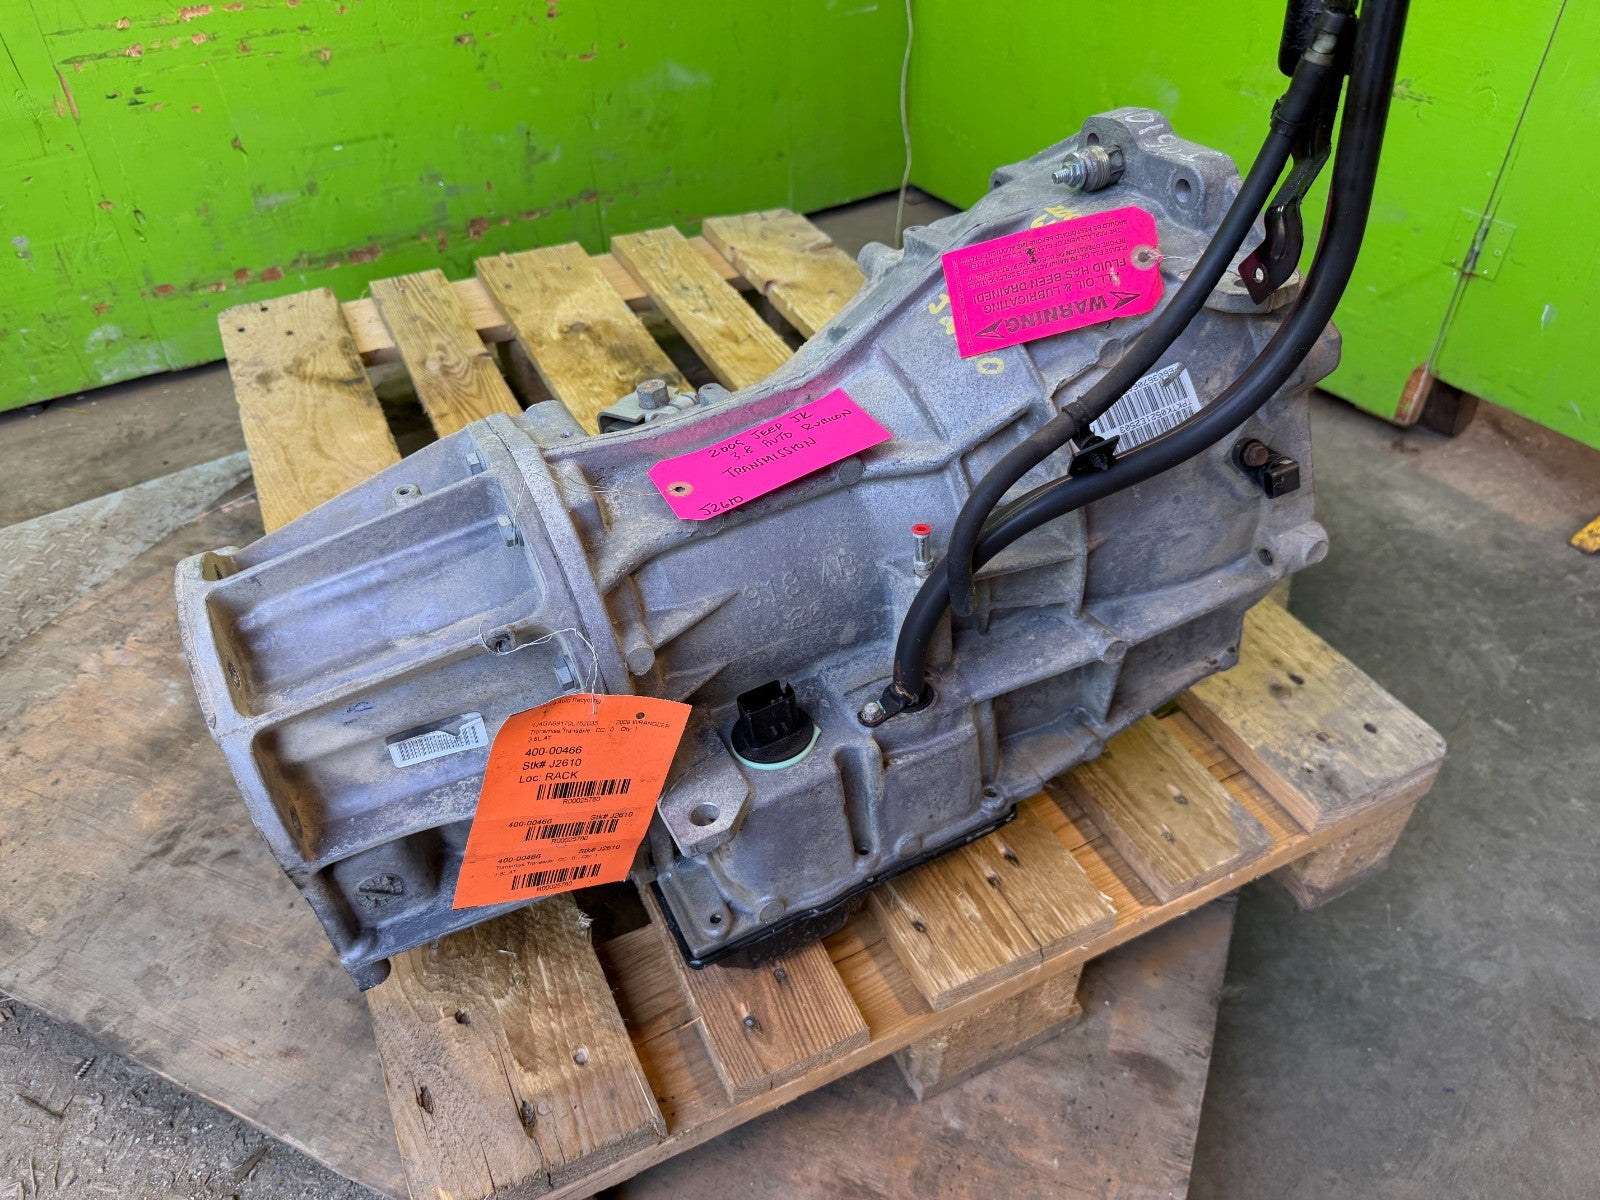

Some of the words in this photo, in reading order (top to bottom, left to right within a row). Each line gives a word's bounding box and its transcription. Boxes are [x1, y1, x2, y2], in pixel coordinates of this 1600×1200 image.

[1104, 244, 1128, 254] PLEASE
[1065, 264, 1091, 277] HAS
[1092, 258, 1126, 272] FLUID
[1033, 271, 1061, 287] BEEN
[1076, 278, 1094, 289] OIL
[1103, 271, 1119, 284] ALL
[973, 279, 1029, 304] DRAINED!
[1065, 283, 1071, 292] &
[983, 286, 1060, 314] LUBRICATING
[1005, 295, 1108, 332] WARNING
[733, 446, 751, 460] 3.8
[762, 432, 792, 448] AUTO
[801, 410, 851, 431] RUBICON
[750, 423, 782, 440] JEEP
[722, 437, 816, 478] TRANSMISSION
[699, 495, 744, 516] J2610
[632, 720, 670, 728] WRANGLER
[525, 746, 582, 756] 400-00466
[522, 761, 546, 770] Stk#
[549, 759, 582, 768] J2610
[519, 775, 541, 784] Loc:
[545, 771, 578, 780] RACK
[508, 819, 552, 828] 400-00466
[551, 836, 588, 844] R00025780
[497, 854, 541, 863] 400-00466
